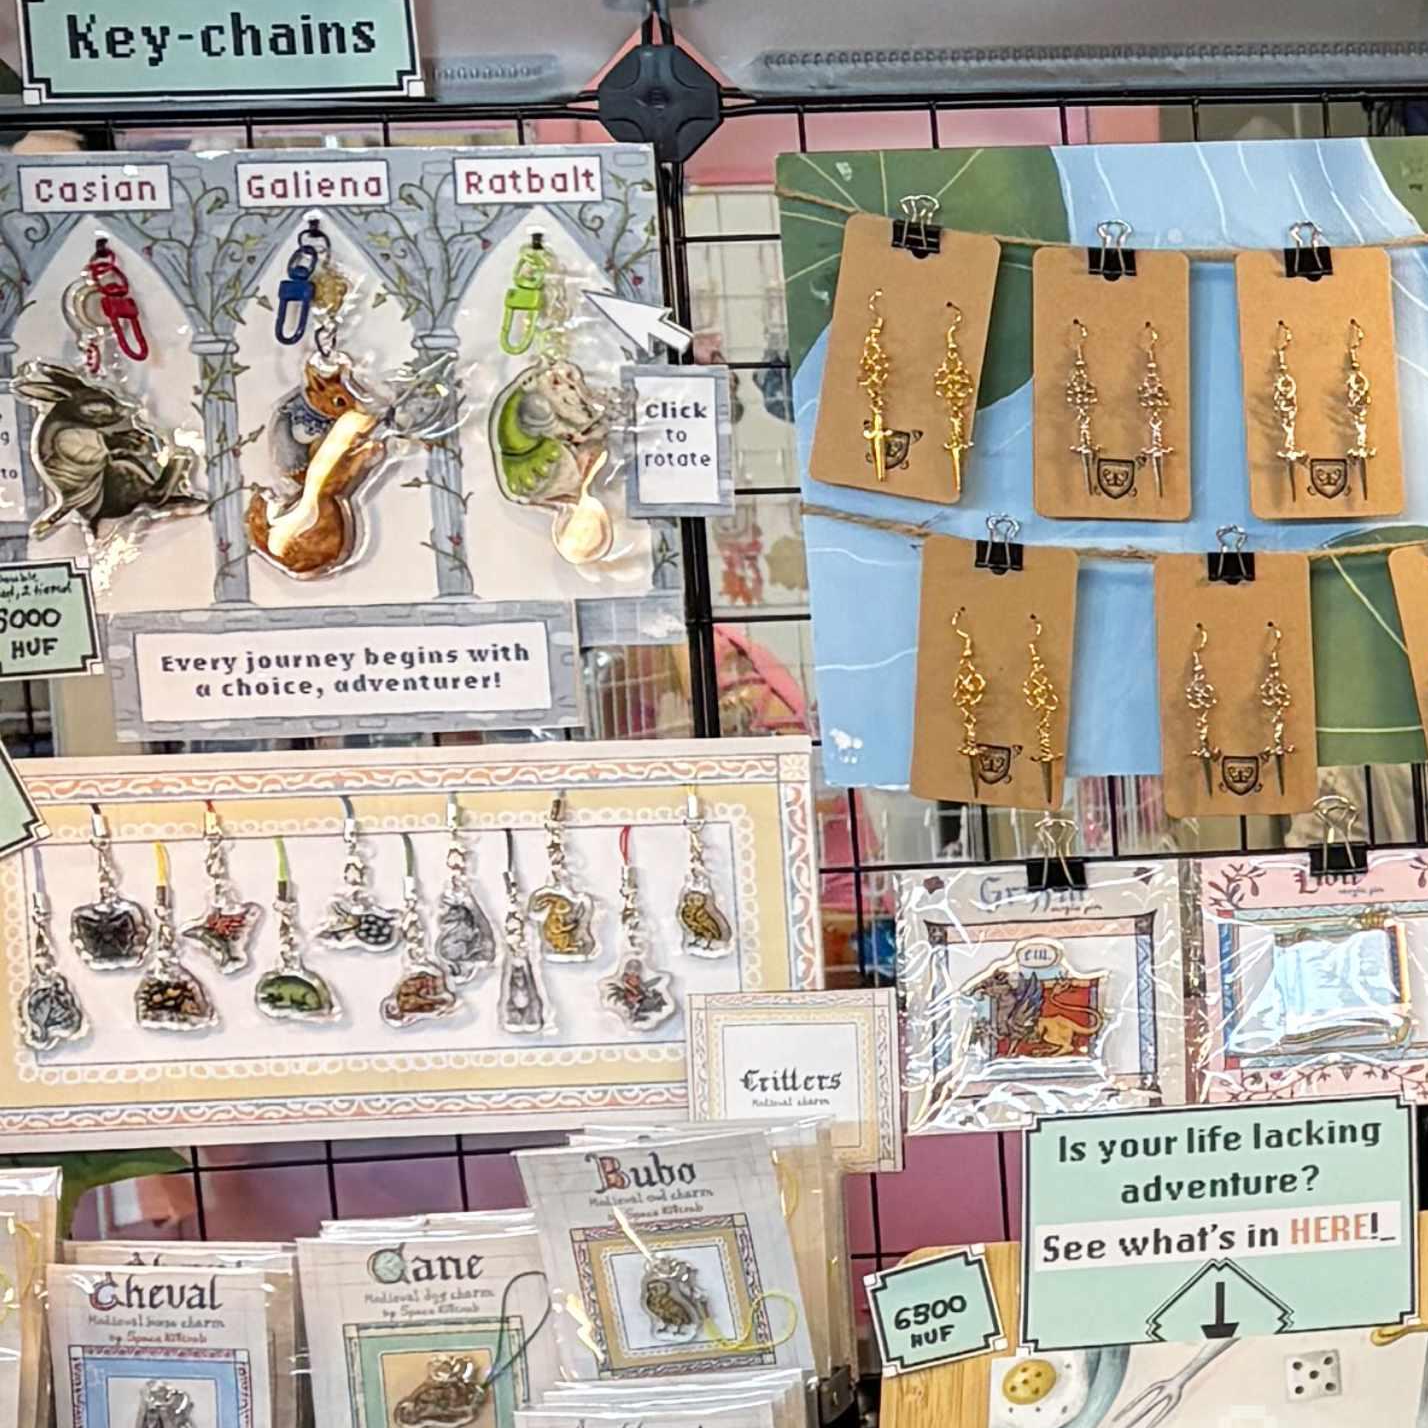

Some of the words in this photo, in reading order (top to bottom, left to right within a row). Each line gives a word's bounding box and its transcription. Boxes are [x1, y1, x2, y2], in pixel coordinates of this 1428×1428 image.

[67, 13, 378, 65] Key-chains
[35, 177, 157, 203] Casian
[246, 172, 383, 200] Galiena
[465, 166, 596, 197] Ratbalt
[645, 401, 708, 422] Click
[665, 427, 687, 444] to
[645, 450, 712, 468] rotate
[11, 638, 58, 660] HUF
[161, 651, 236, 675] Every
[245, 648, 356, 673] journey
[364, 642, 458, 672] begins
[467, 643, 530, 664] with
[196, 681, 213, 696] a
[222, 674, 325, 699] choice,
[334, 670, 502, 693] adventurer!
[740, 1069, 842, 1092] Critters
[1058, 1137, 1086, 1163] Is
[1097, 1130, 1177, 1164] your
[1185, 1125, 1242, 1155] life
[1251, 1118, 1381, 1156] lacking
[585, 1151, 697, 1194] Bubo
[1119, 1165, 1320, 1206] adventure?
[1043, 1233, 1106, 1263] See
[1119, 1224, 1236, 1259] what's
[1247, 1223, 1279, 1249] in
[89, 1271, 224, 1311] Cheval
[910, 1324, 954, 1349] HUF
